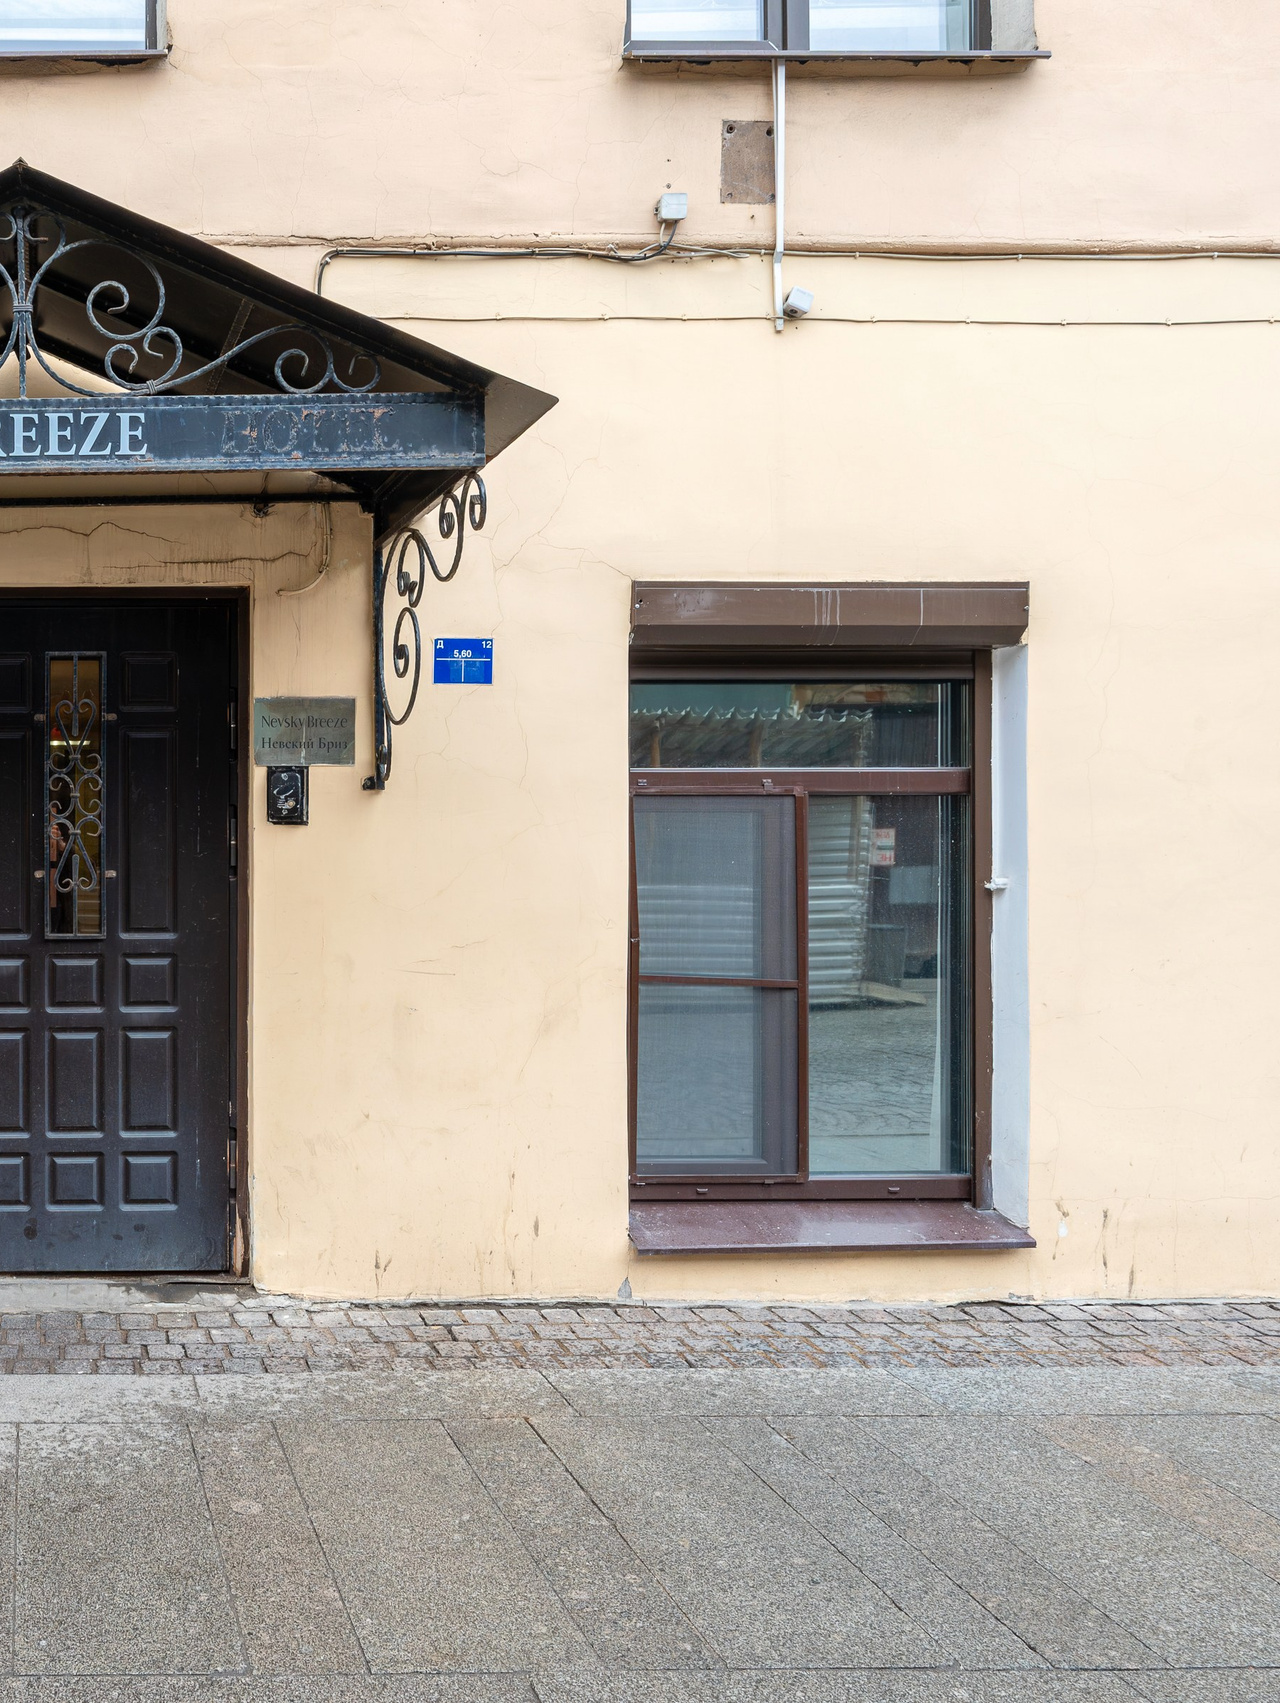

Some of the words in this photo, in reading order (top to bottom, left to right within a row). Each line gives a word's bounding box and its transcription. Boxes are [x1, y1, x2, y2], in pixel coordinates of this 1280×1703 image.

[436, 640, 445, 649] Д
[481, 640, 492, 649] 12
[453, 649, 472, 659] 5,60
[261, 715, 306, 731] Nevsky
[307, 715, 348, 729] Breeze
[261, 737, 315, 750] Невский
[318, 737, 349, 753] Бриз
